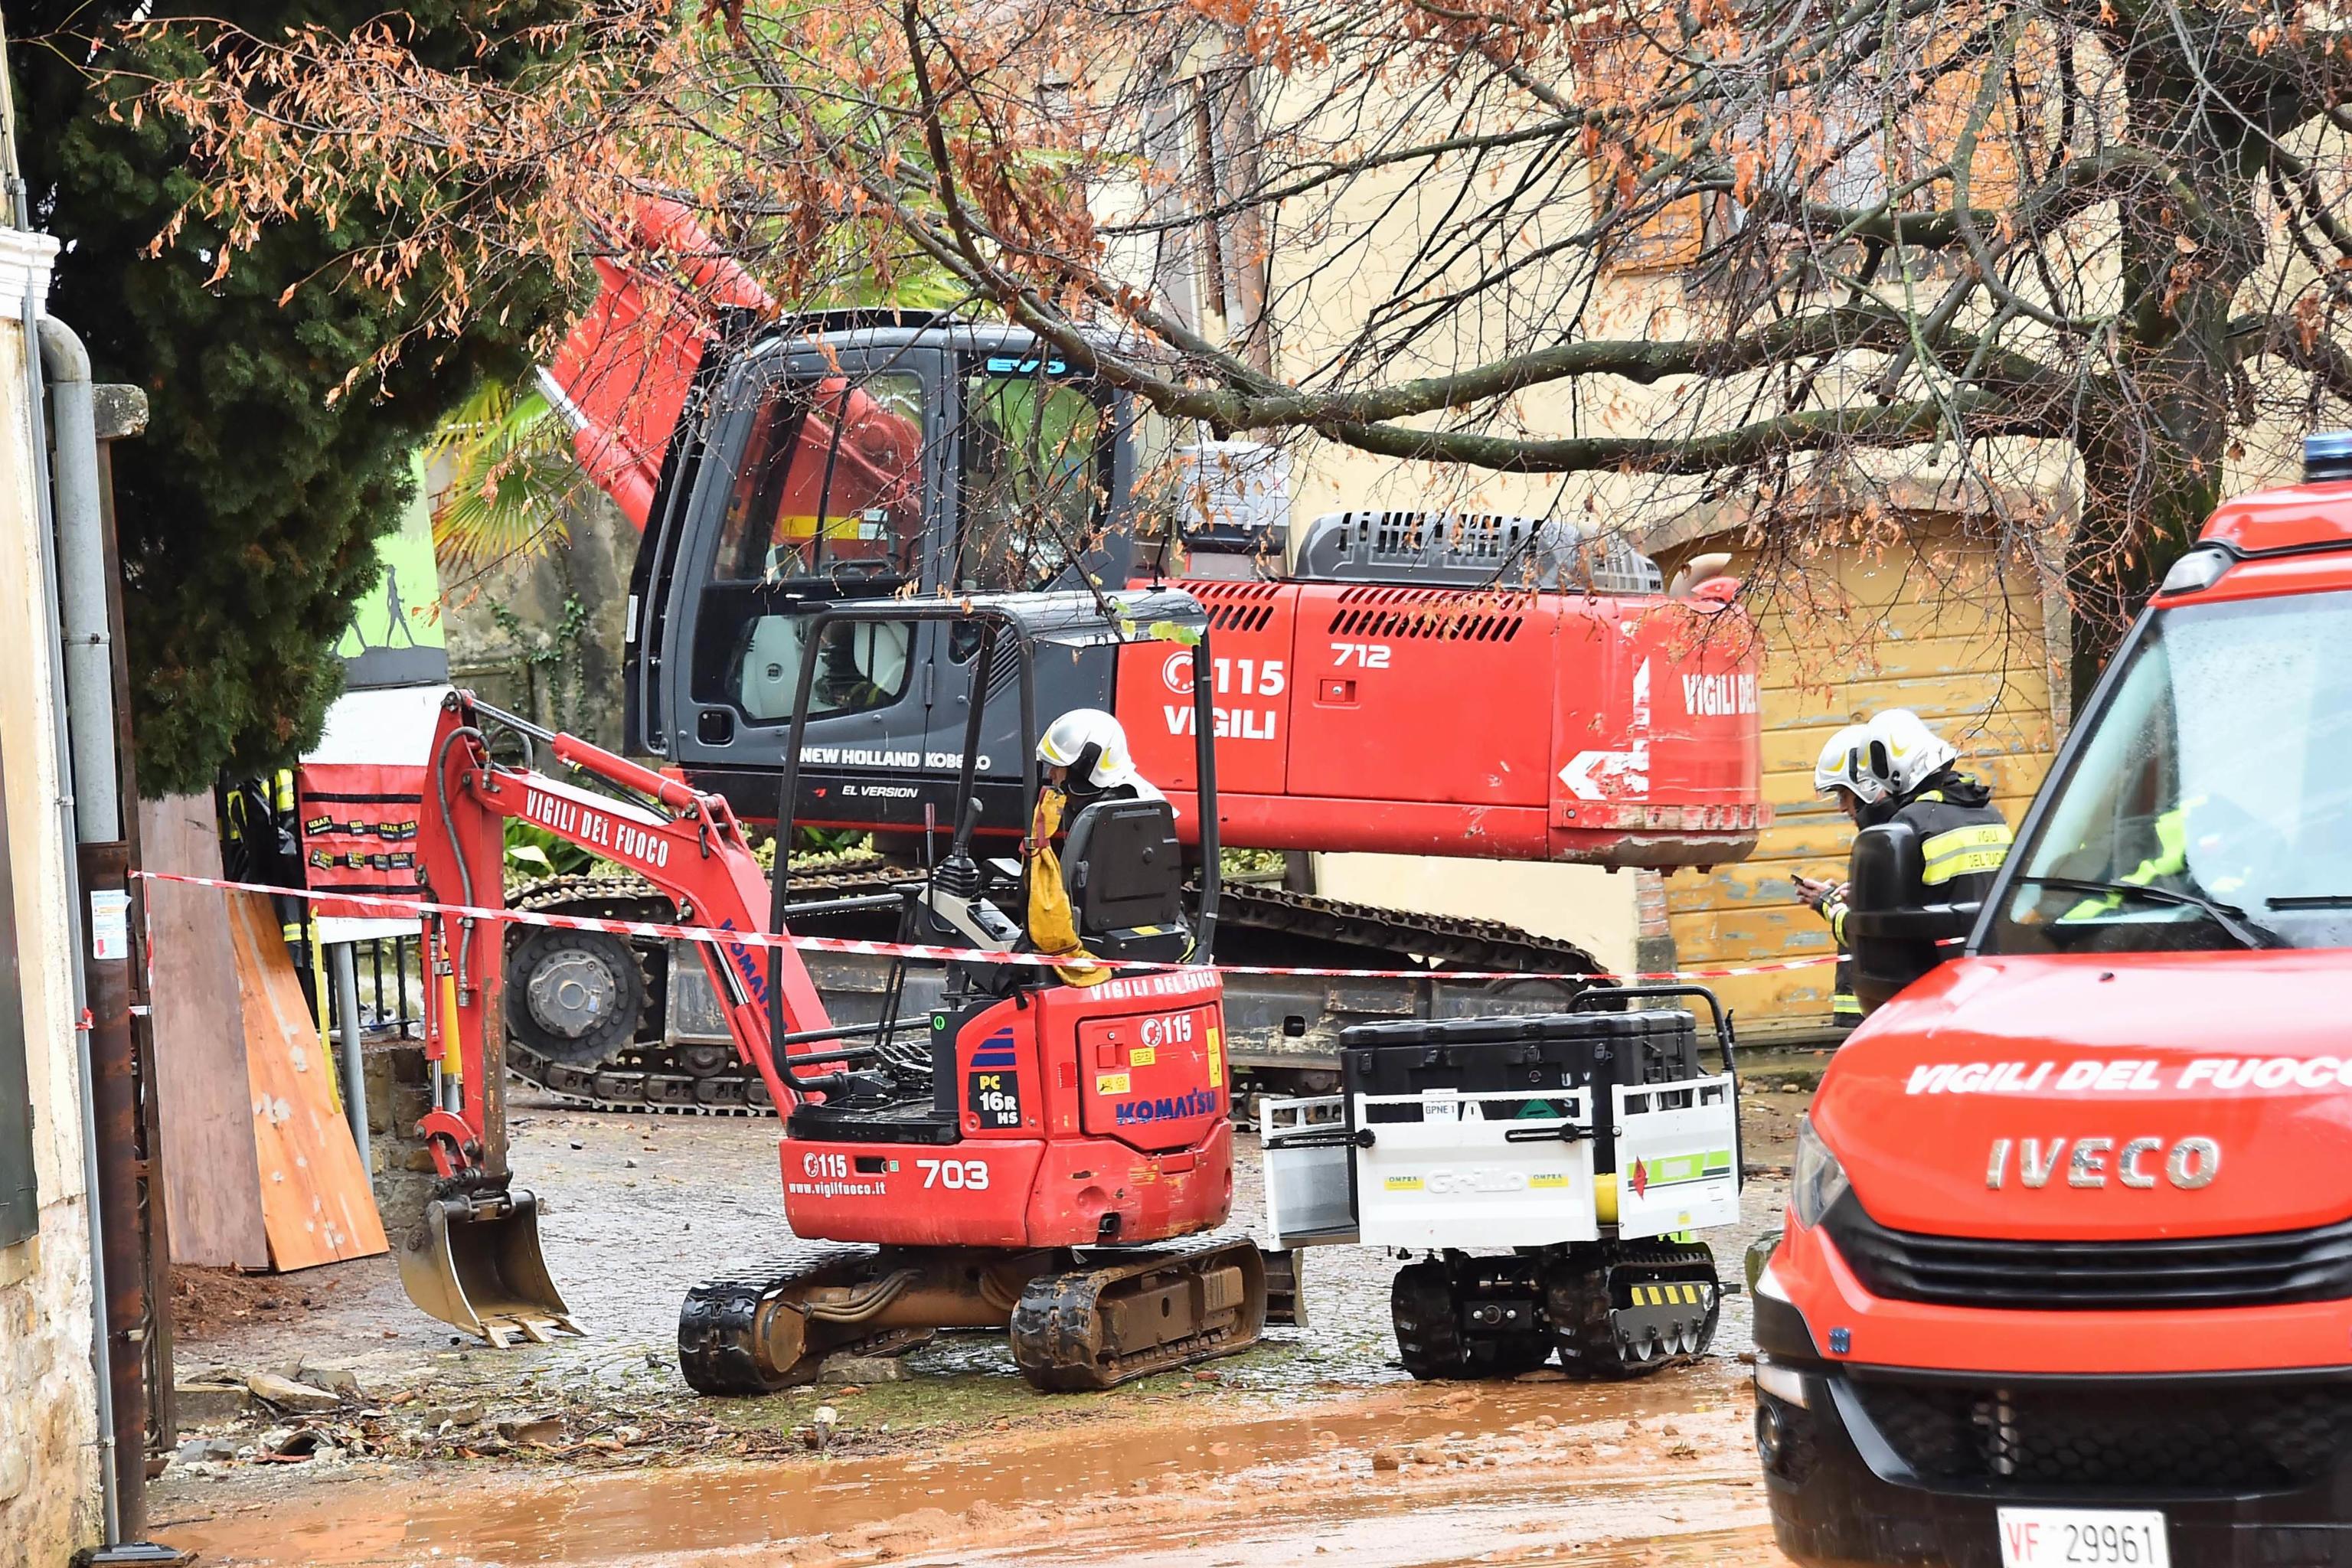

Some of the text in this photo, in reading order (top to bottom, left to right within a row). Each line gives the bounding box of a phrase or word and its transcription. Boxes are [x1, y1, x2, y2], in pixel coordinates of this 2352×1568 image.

[1331, 643, 1391, 668] 712
[1214, 658, 1285, 696] 115
[1682, 674, 1736, 716] VIGILI
[1164, 705, 1276, 740] VIGILI
[799, 747, 991, 771] NEW HOLLAND KOBEO
[842, 786, 919, 799] EL VERSION
[526, 789, 668, 867] VIGILI DEL FUOCO
[1090, 979, 1148, 1001] VIGILI
[1153, 974, 1185, 995] DEL
[1162, 1014, 1191, 1044] 115
[979, 1075, 1000, 1090] PC
[1905, 1061, 2056, 1095] VIGILI
[2055, 1060, 2161, 1090] DEL
[979, 1092, 1017, 1111] 16R
[1116, 1087, 1217, 1126] KOMATSU
[997, 1112, 1018, 1125] HS
[818, 1154, 846, 1178] 115
[916, 1159, 989, 1190] 703
[1985, 1137, 2220, 1190] IVECO
[789, 1181, 886, 1198] www.vigilfuoco.it
[2007, 1523, 2154, 1564] VF 29961
